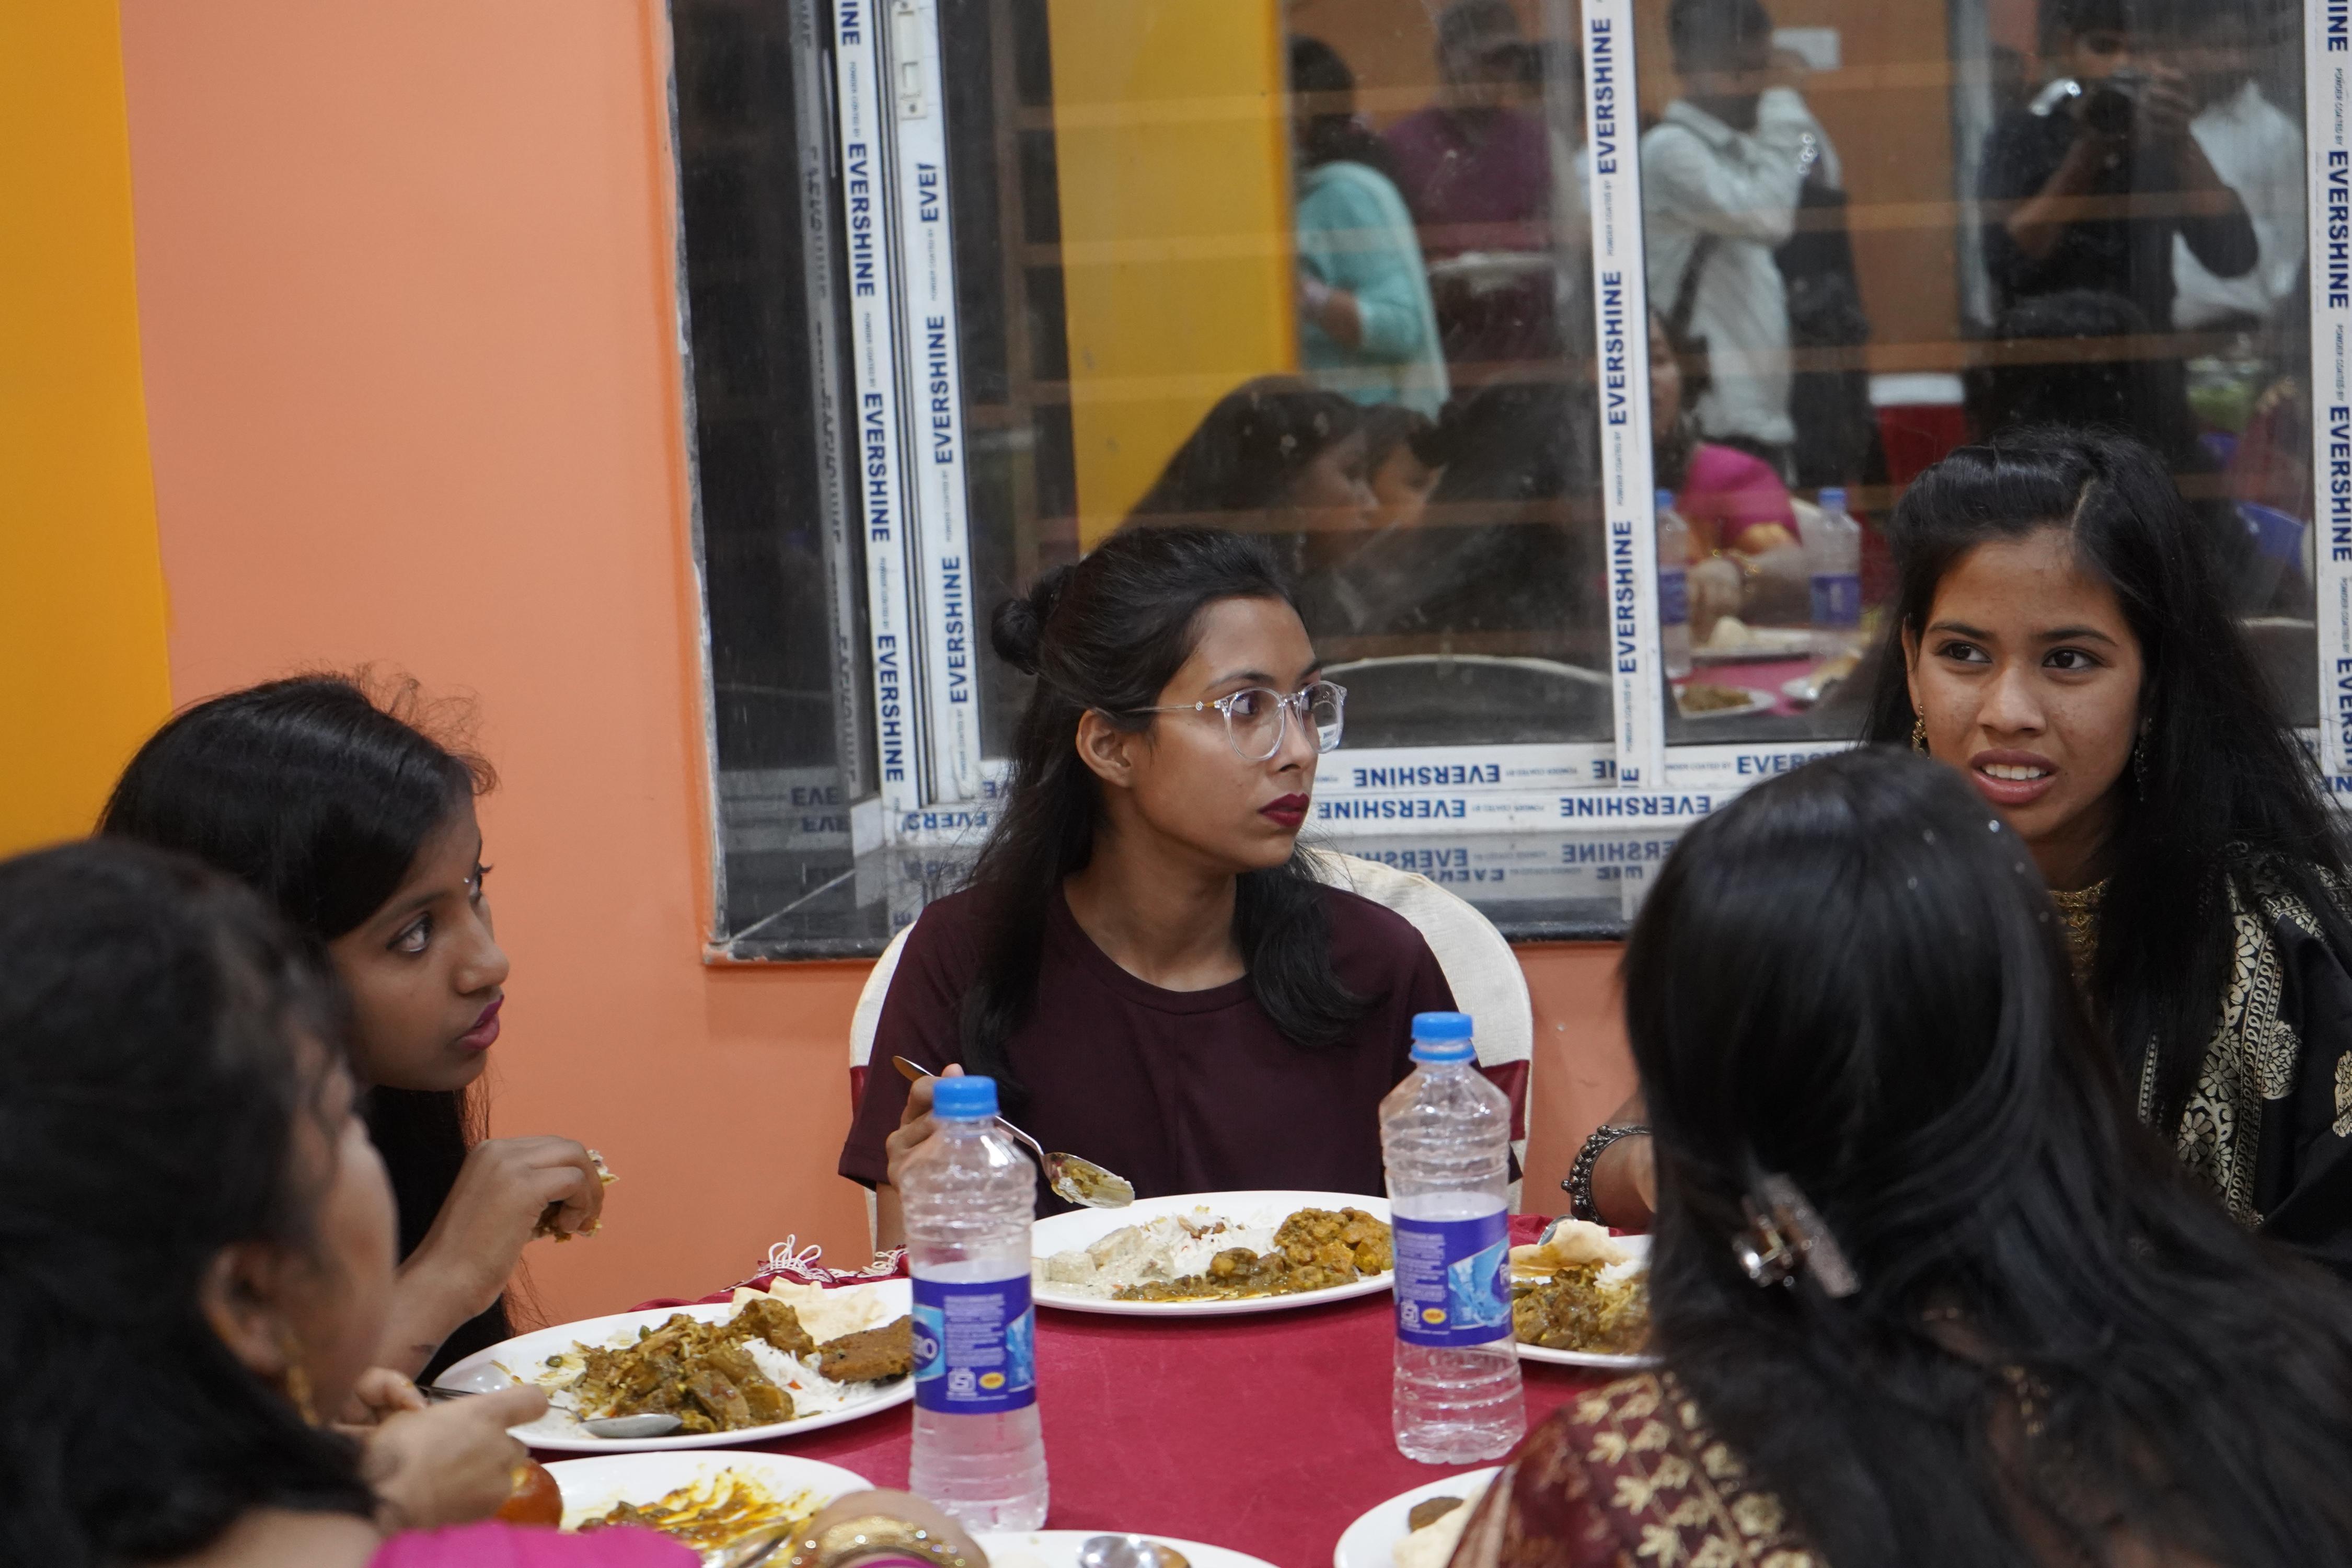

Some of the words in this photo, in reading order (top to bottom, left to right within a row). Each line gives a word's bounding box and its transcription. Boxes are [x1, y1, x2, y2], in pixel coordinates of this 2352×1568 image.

[1592, 19, 1616, 175] EVERSHINE
[848, 143, 874, 297] EVERSHINE
[2328, 151, 2348, 308] EVERSHINE
[927, 316, 953, 465] EVERSHINE
[1603, 271, 1627, 425] EVERSHINE
[864, 393, 890, 543] EVERSHINE
[2330, 406, 2352, 561] EVERSHINE
[942, 556, 968, 704] EVERSHINE
[1613, 522, 1636, 673] EVERSHINE
[878, 635, 904, 782] EVERSHINE
[1353, 764, 1501, 788] EVERSHINE
[902, 811, 988, 832] EVERS
[1319, 799, 1466, 820] EVERSHINE
[1560, 795, 1711, 817] EVERSHINE
